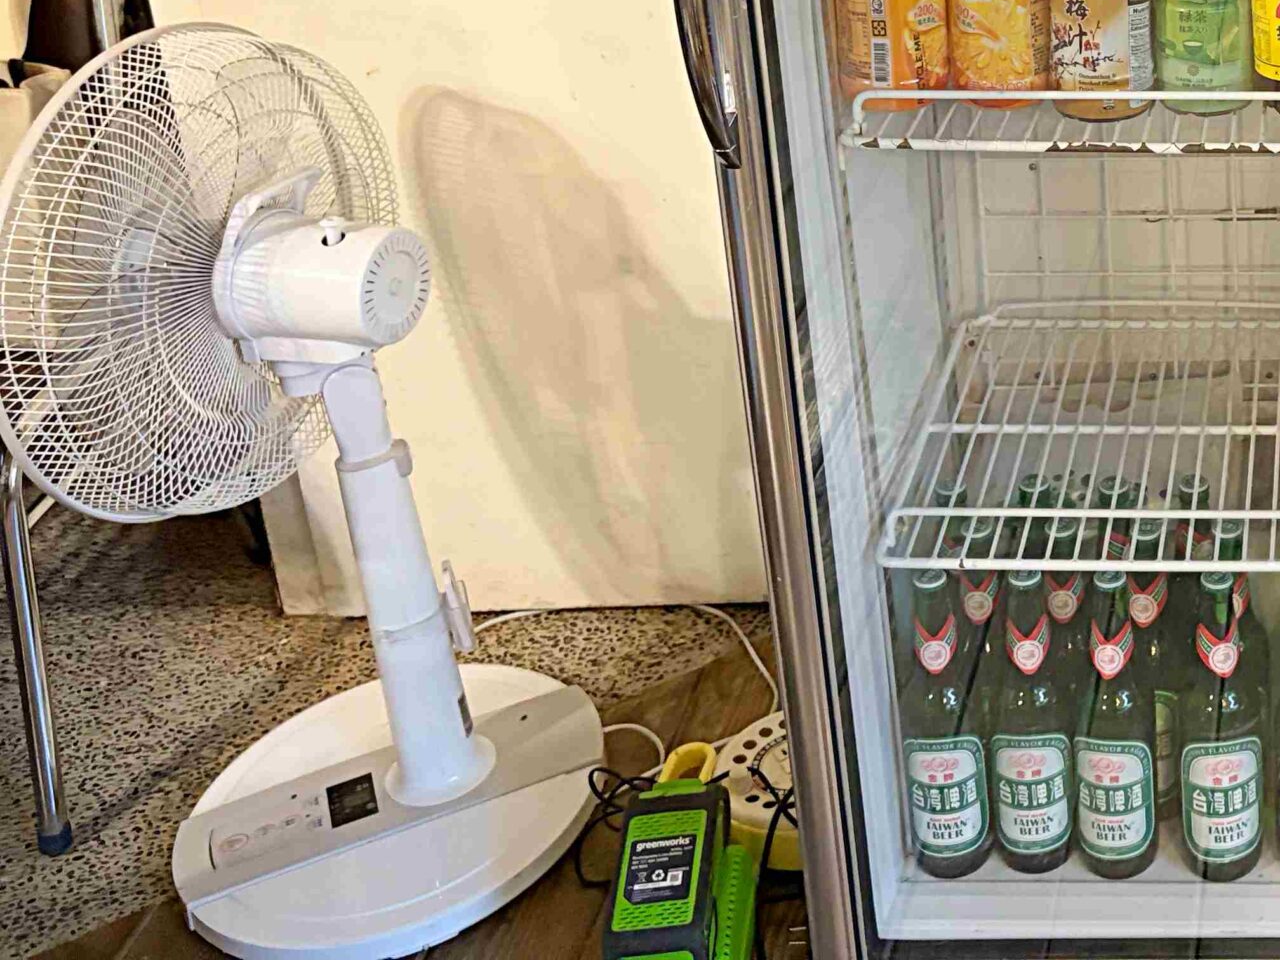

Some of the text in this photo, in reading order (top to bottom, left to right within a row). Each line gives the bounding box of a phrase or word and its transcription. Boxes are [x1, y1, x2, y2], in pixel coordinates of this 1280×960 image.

[926, 820, 967, 830] TAIWAN
[1014, 816, 1054, 827] TAIWAN
[1091, 821, 1131, 832] TAIWAN
[1020, 825, 1050, 835] BEER
[1208, 821, 1248, 834] TAIWAN
[933, 830, 963, 840] BEER
[1097, 832, 1127, 841] BEER
[1214, 831, 1244, 844] BEER
[636, 837, 690, 852] greenworks
